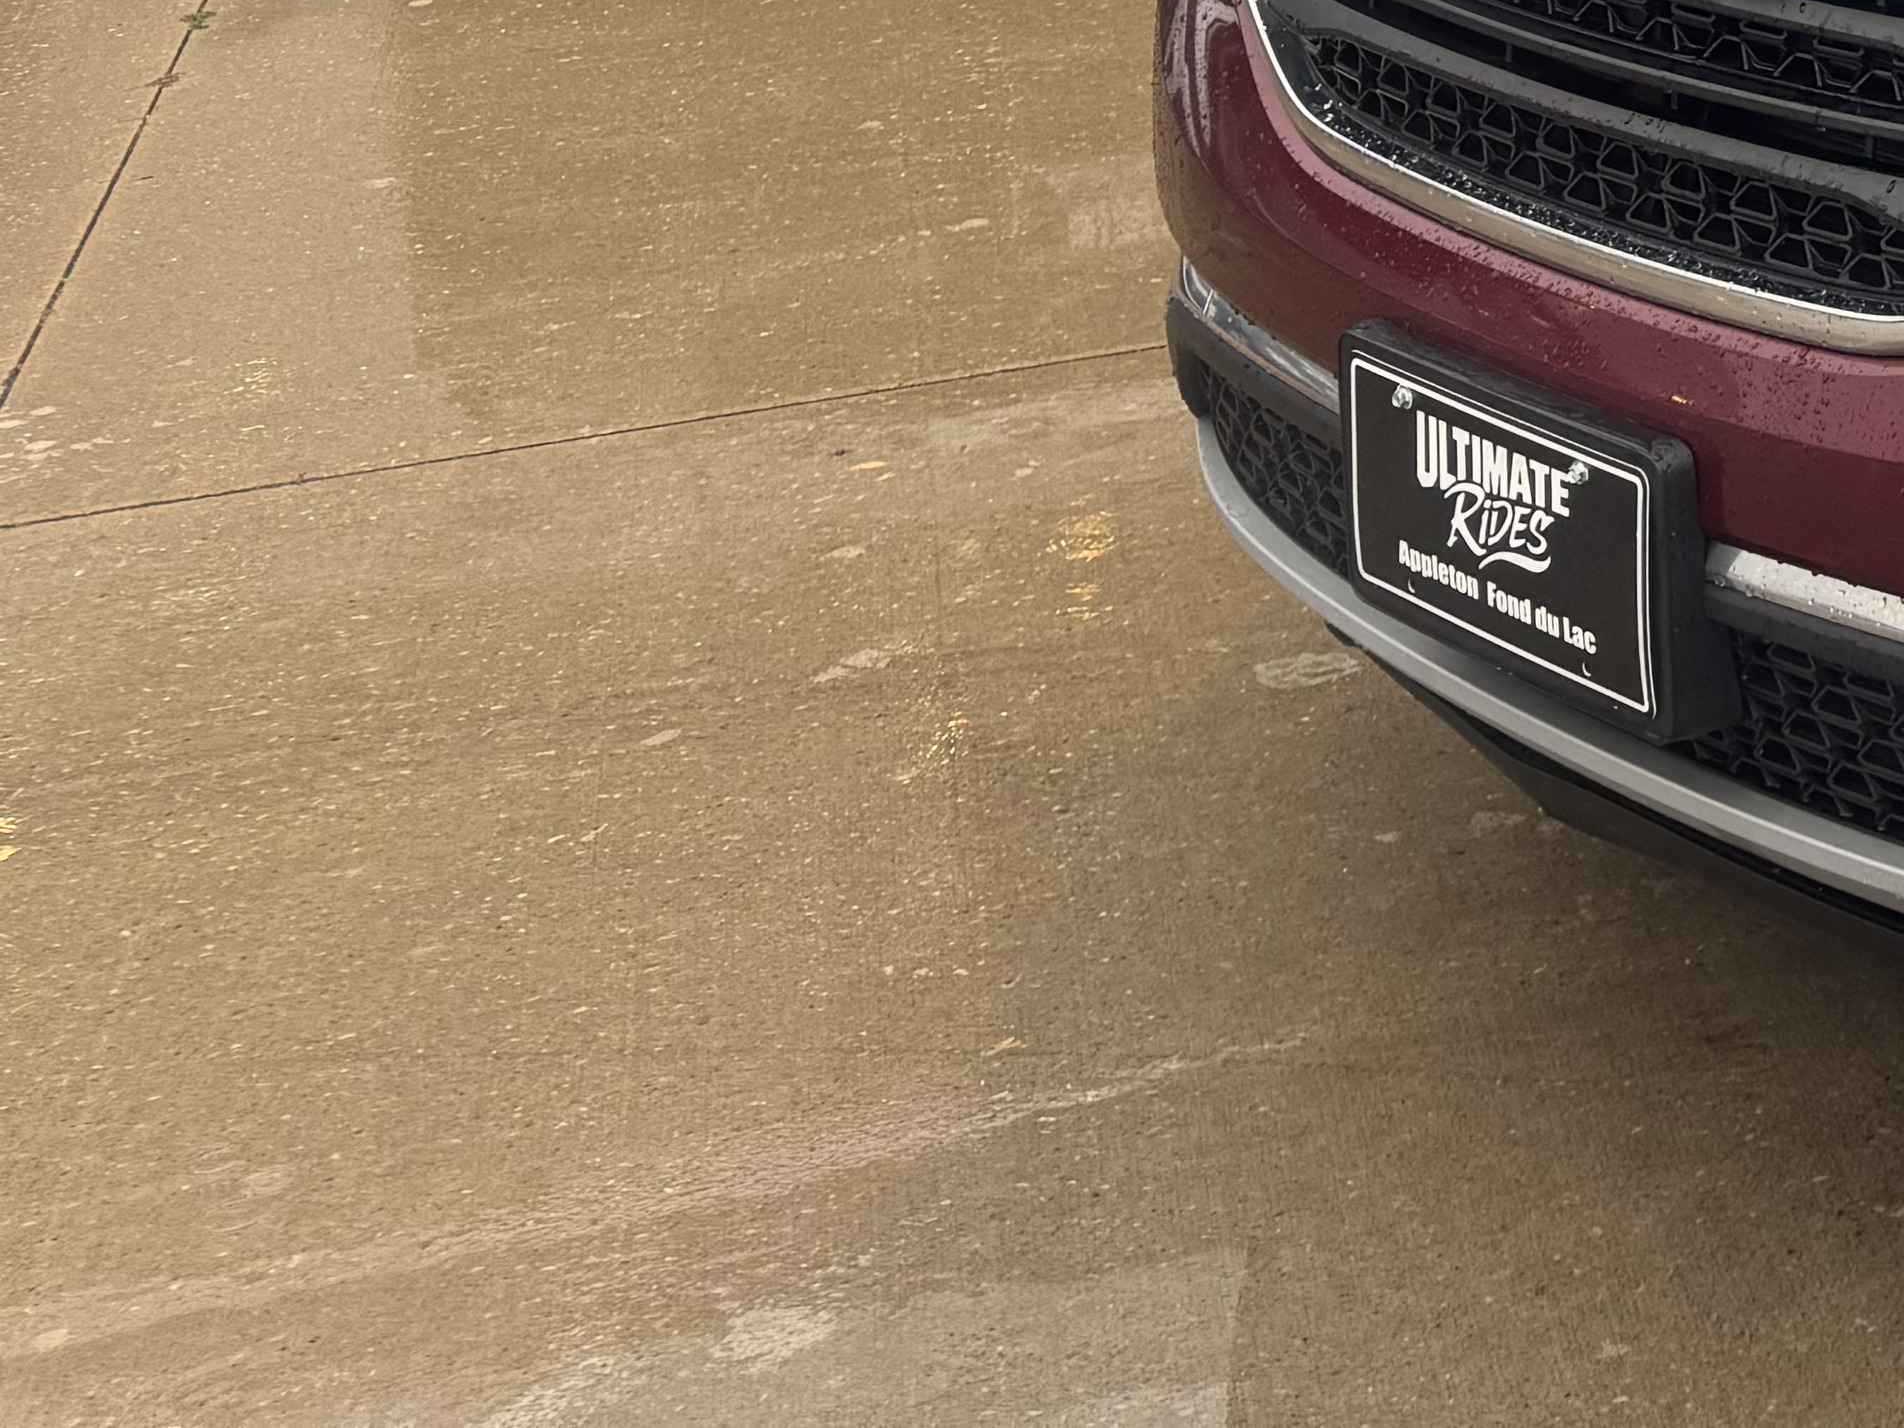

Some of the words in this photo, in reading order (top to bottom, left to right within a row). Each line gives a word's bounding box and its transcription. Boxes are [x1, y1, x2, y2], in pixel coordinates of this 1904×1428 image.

[1416, 410, 1570, 518] ULTIMATE
[1398, 540, 1480, 602] Appleton
[1487, 581, 1532, 626] Fond
[1535, 605, 1559, 639] du
[1564, 616, 1597, 656] Lac
